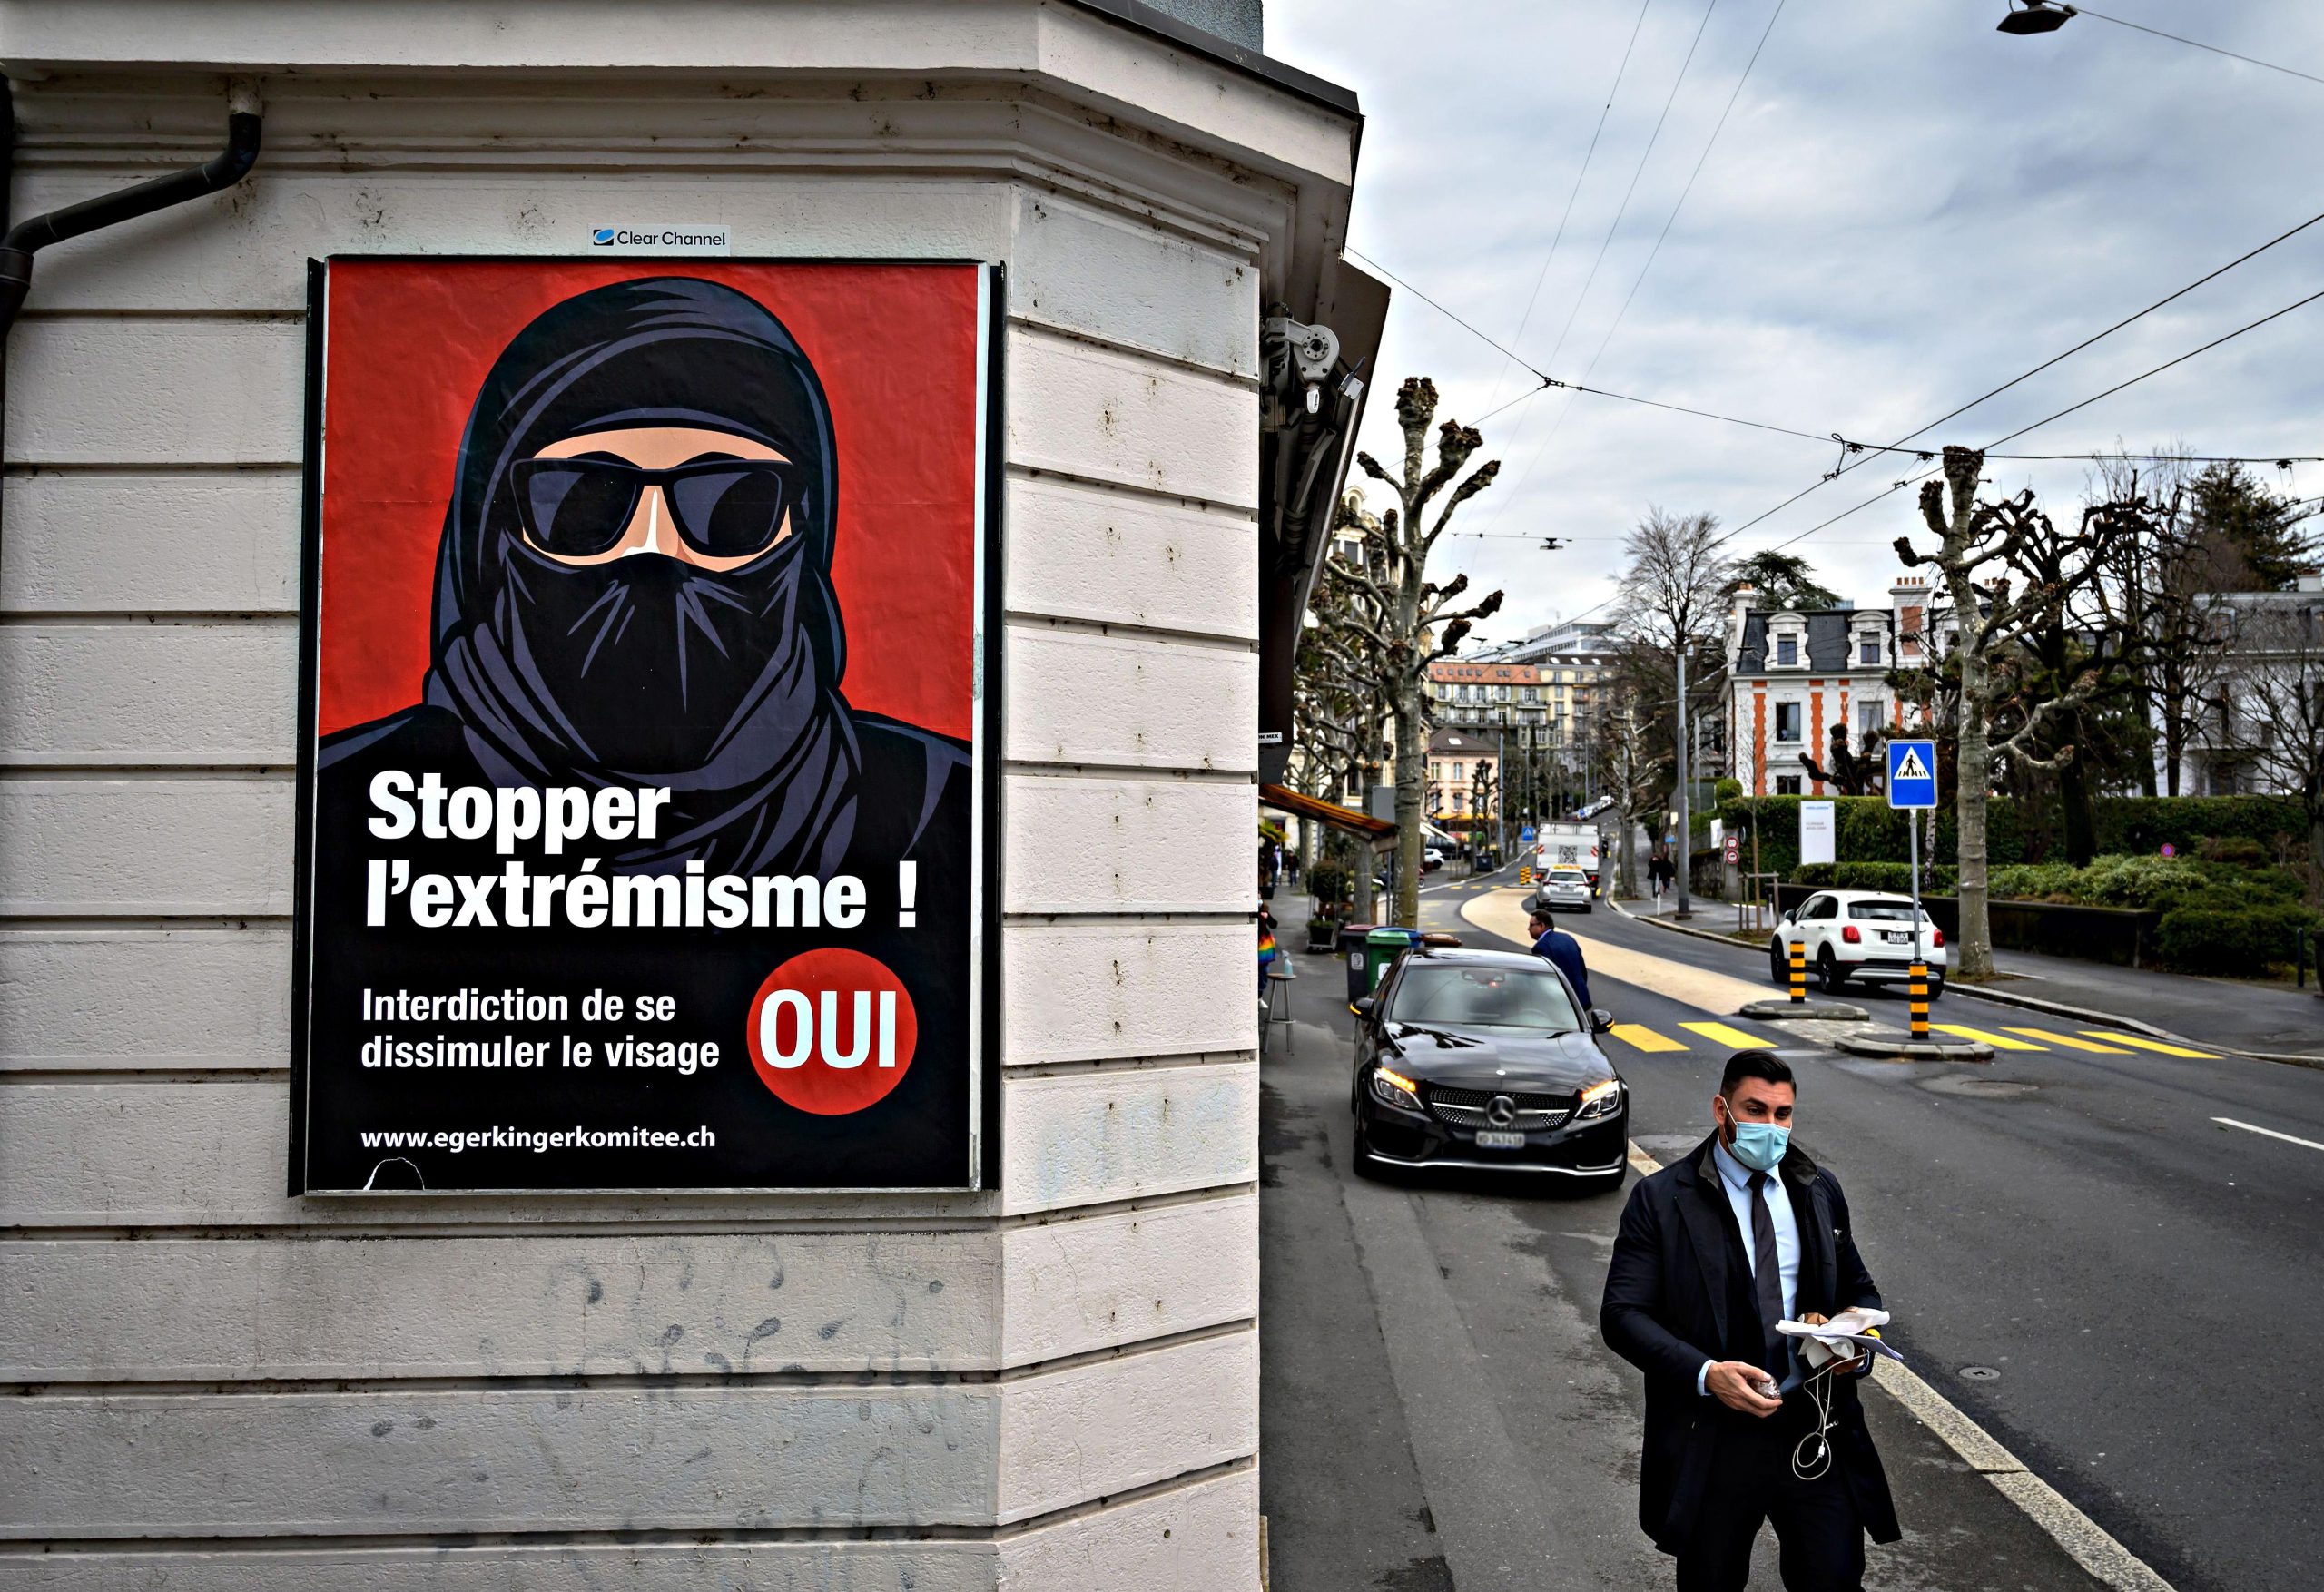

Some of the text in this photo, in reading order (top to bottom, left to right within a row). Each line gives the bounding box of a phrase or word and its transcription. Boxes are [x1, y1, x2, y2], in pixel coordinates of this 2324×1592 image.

[616, 231, 726, 246] Clear Channel
[368, 770, 671, 855] Stopper
[899, 860, 917, 928] !
[363, 988, 675, 1022] Interdiction de se
[759, 988, 897, 1069] OUI
[361, 1034, 720, 1076] dissimuler le visage
[360, 1125, 715, 1154] www.egerkingerkomitee.ch
